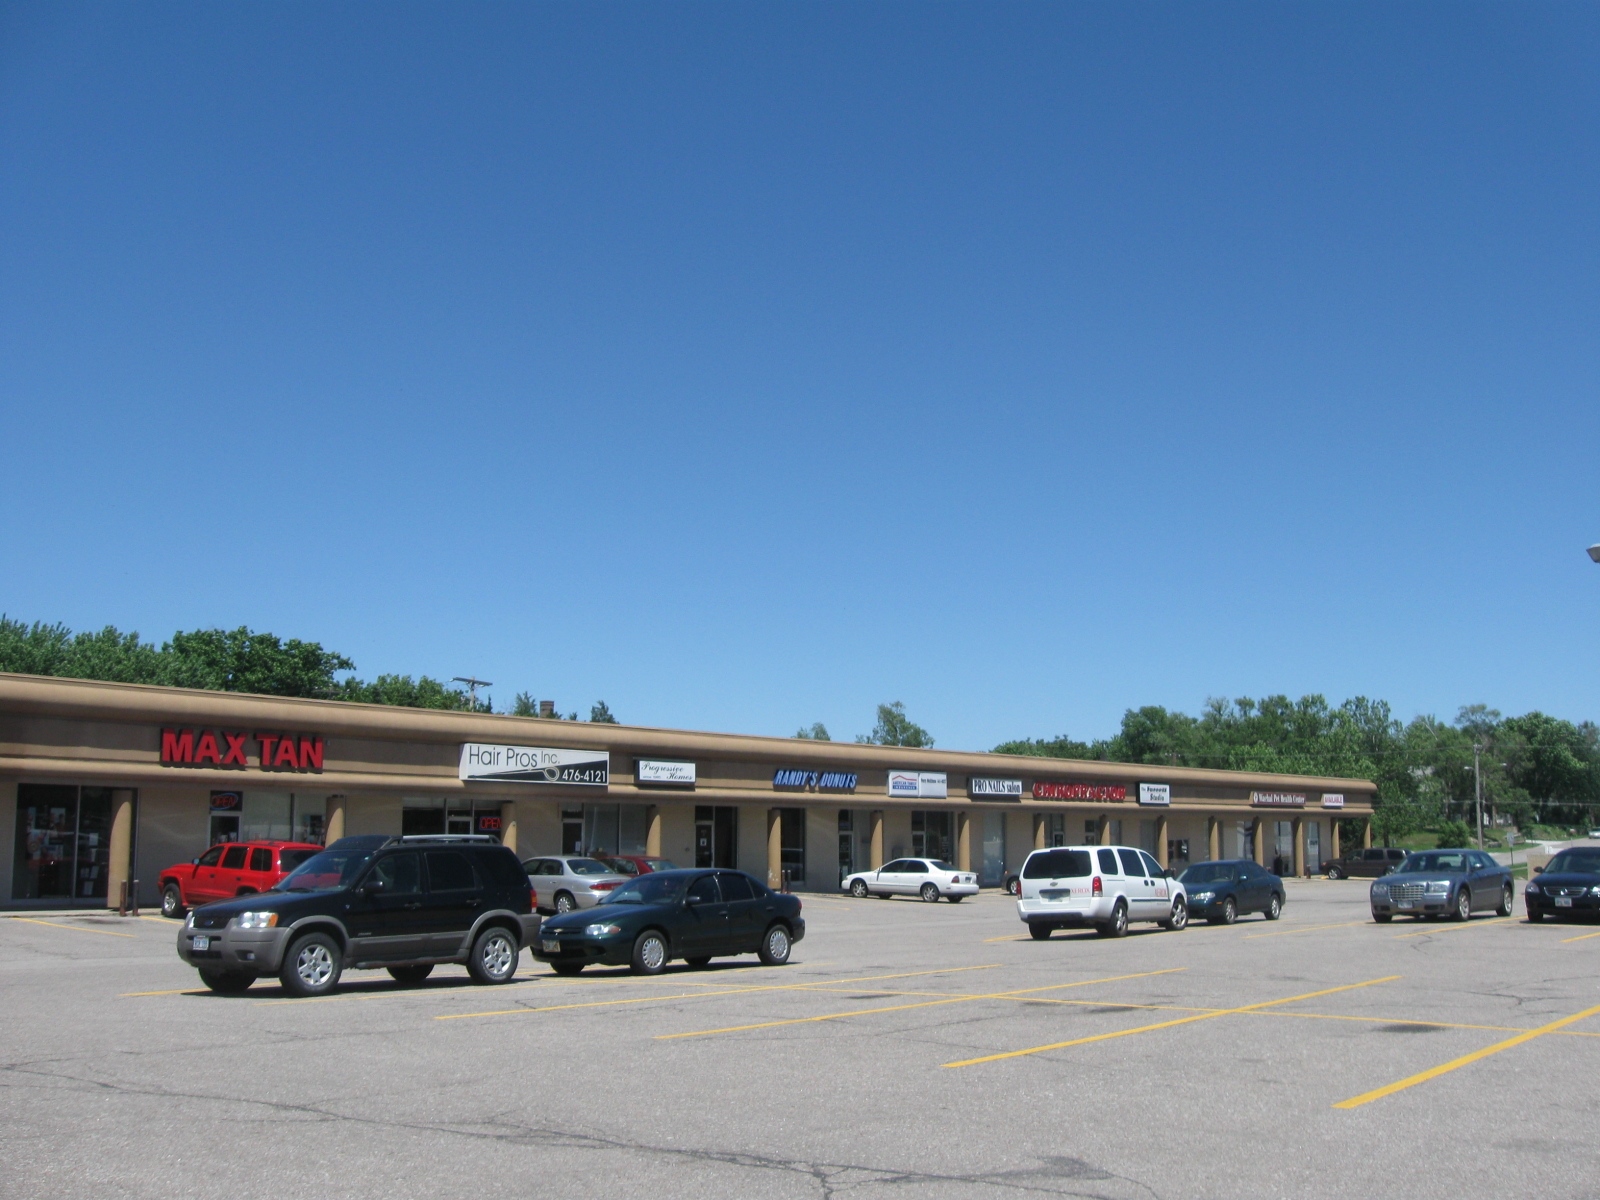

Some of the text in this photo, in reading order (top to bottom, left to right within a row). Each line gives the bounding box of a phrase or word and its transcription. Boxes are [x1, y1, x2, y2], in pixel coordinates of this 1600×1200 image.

[161, 728, 323, 769] MAX TAN
[469, 746, 561, 768] Hair Pros Inc.
[641, 761, 684, 774] Progressive
[562, 769, 606, 782] 476-4121
[667, 772, 693, 780] Homes
[774, 769, 857, 788] RANDY'S DONUTS
[974, 779, 1020, 794] PRO NAILS salon
[1032, 782, 1126, 799] CHIROPRACTOR
[212, 795, 236, 807] OPEN
